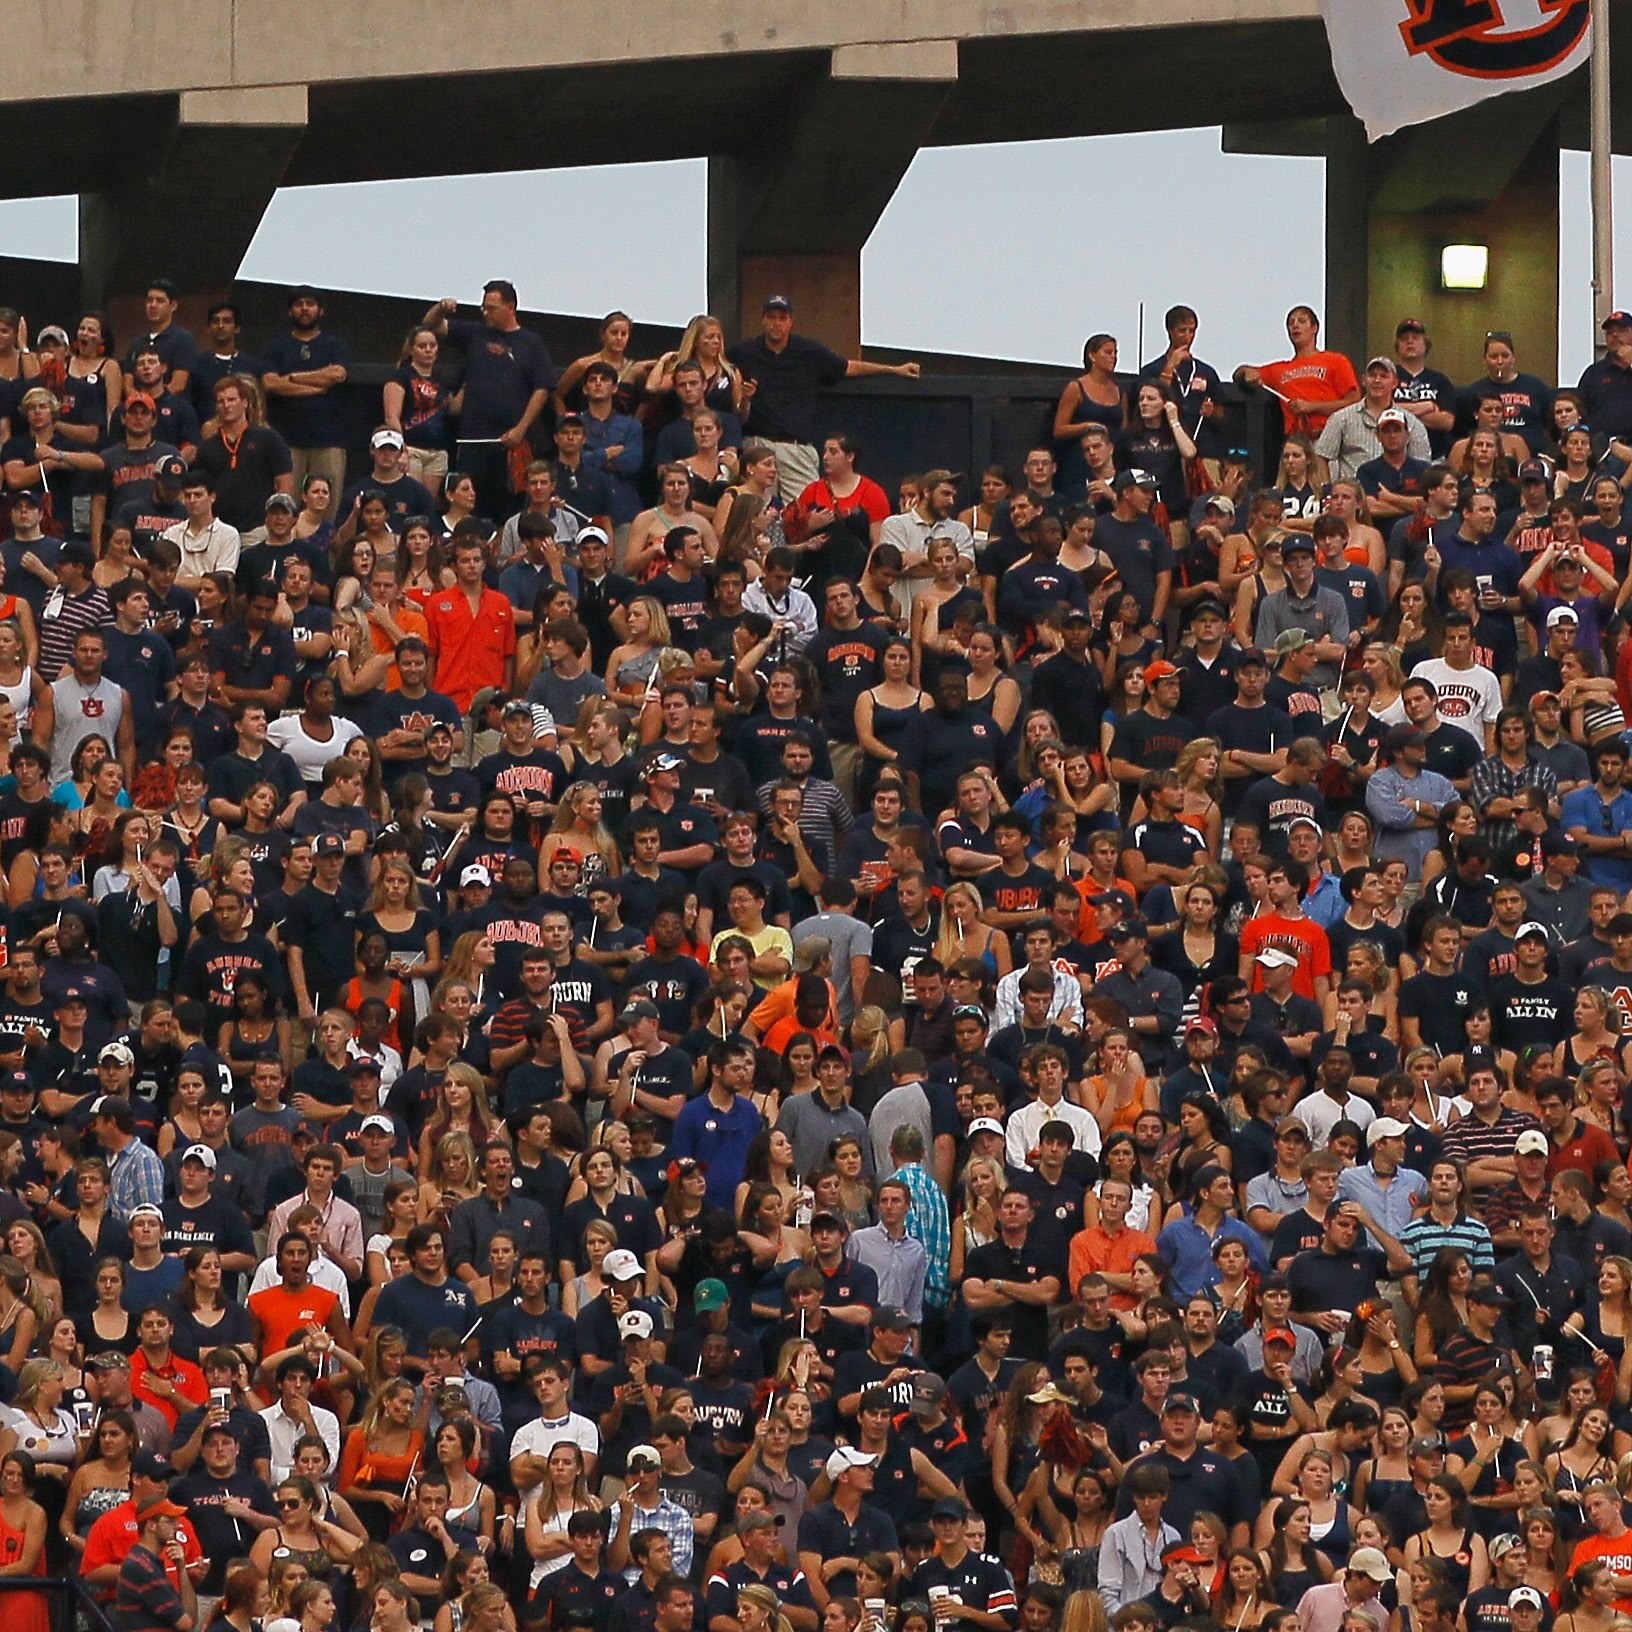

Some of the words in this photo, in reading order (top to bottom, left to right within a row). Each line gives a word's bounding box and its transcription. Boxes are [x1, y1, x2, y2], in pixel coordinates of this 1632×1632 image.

[1281, 496, 1322, 518] 24
[1438, 684, 1481, 711] UBURN
[494, 766, 554, 801] AUBURN
[550, 980, 592, 1003] BURN
[1520, 997, 1551, 1006] FAMILY
[1506, 1005, 1535, 1020] ALL
[1534, 1005, 1559, 1021] IN
[693, 1405, 745, 1428] AUBURN
